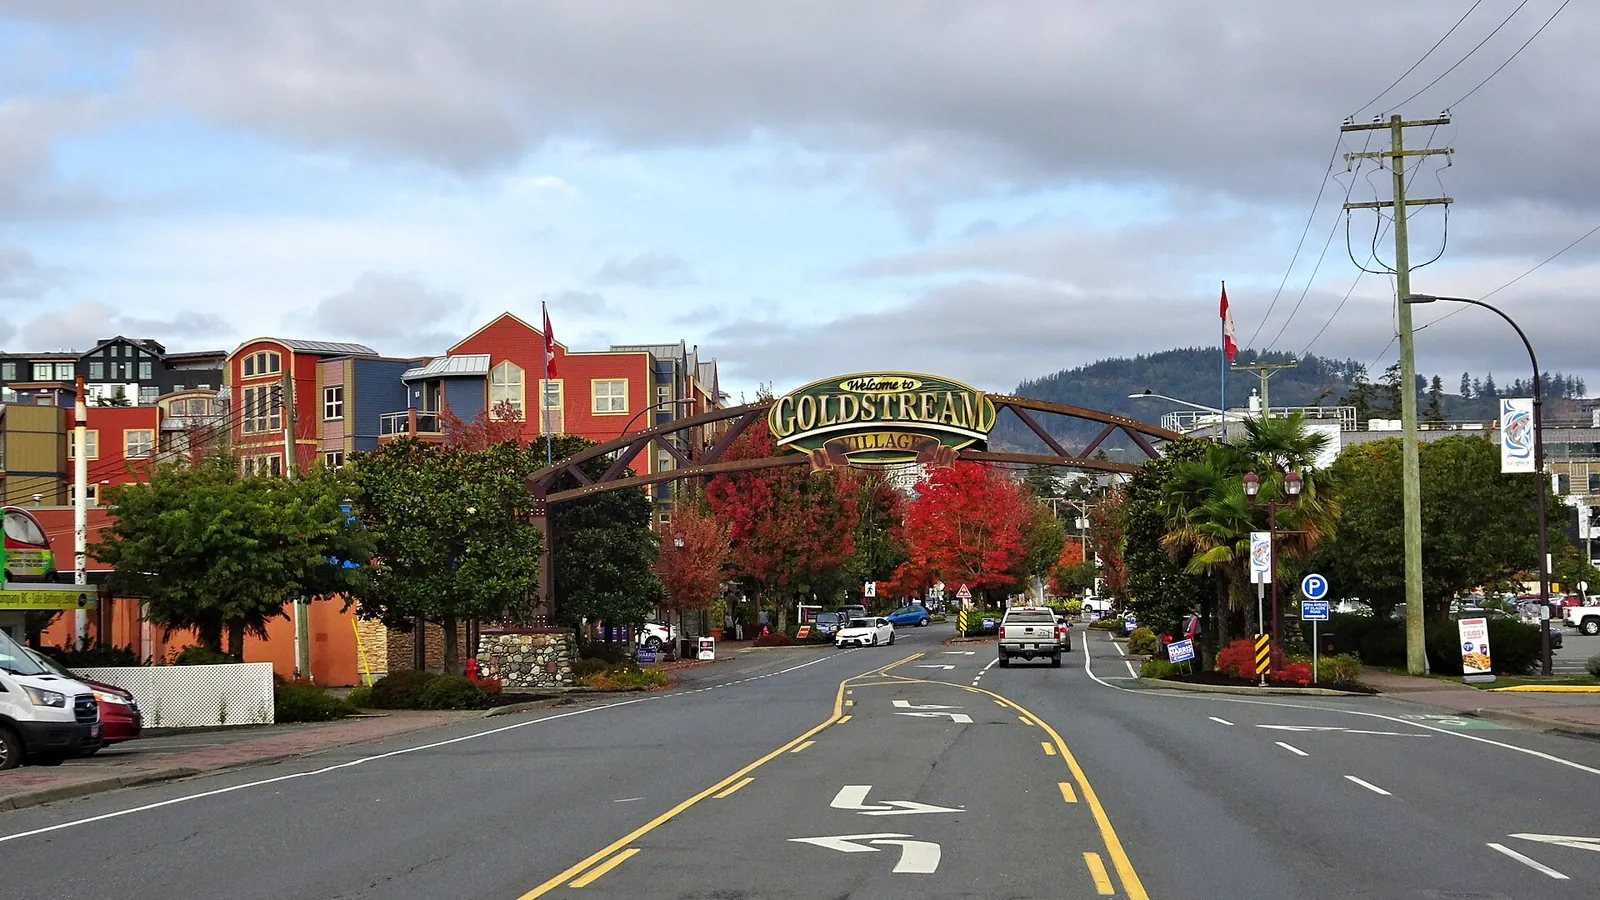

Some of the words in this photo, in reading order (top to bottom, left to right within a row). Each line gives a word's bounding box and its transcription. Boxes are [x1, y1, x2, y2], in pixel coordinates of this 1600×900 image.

[847, 378, 899, 391] Welcome
[902, 380, 914, 390] to
[776, 391, 988, 437] GOLDSTREAM
[841, 433, 921, 450] VILLAGE
[1309, 579, 1321, 595] P
